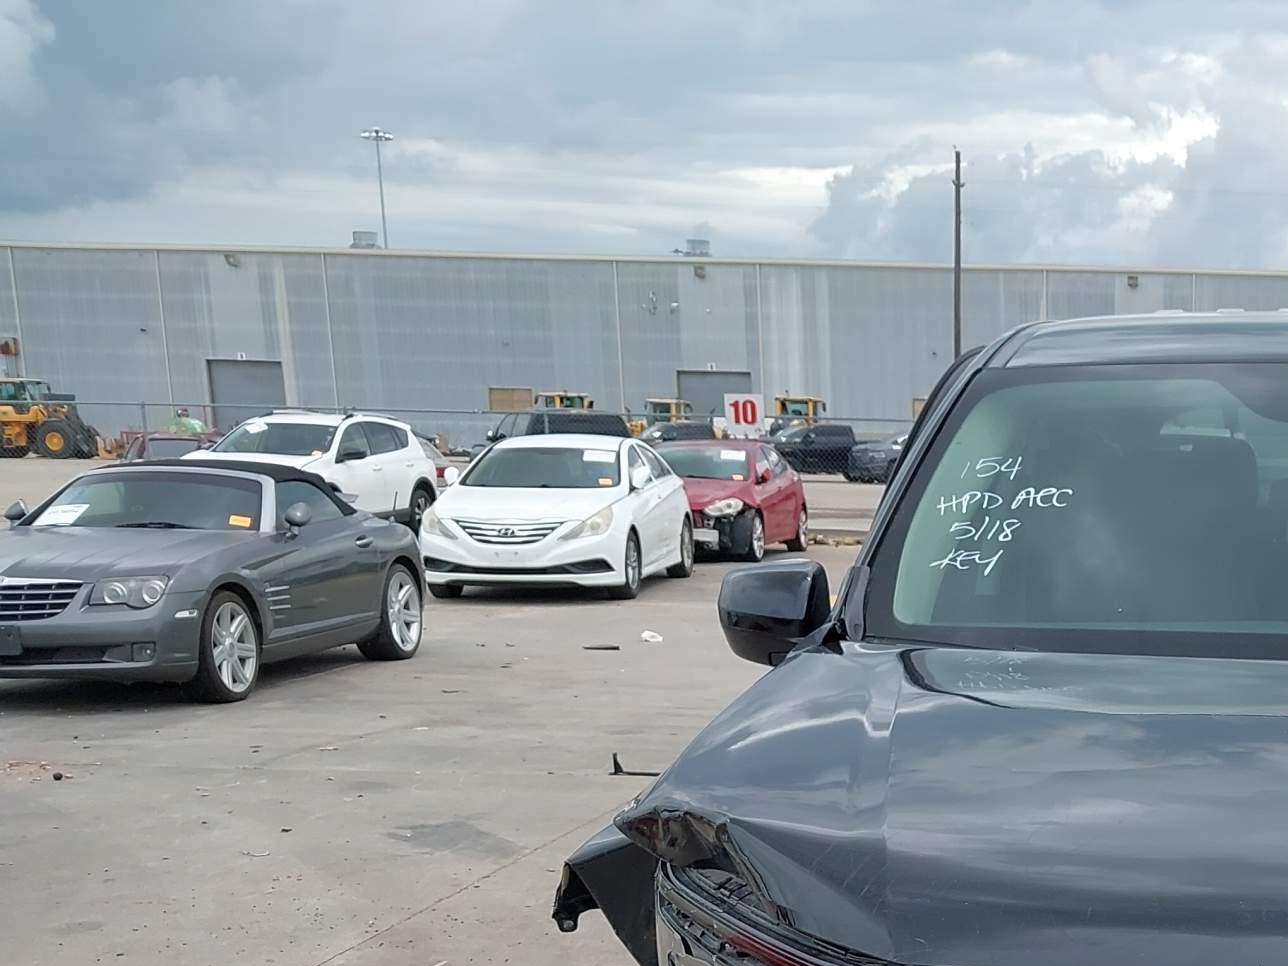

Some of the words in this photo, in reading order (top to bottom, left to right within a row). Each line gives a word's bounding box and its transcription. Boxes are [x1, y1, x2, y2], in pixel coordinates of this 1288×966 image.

[729, 399, 758, 426] 10
[960, 455, 1023, 481] 154
[936, 490, 1003, 516] HPD
[949, 516, 1022, 542] 5/18
